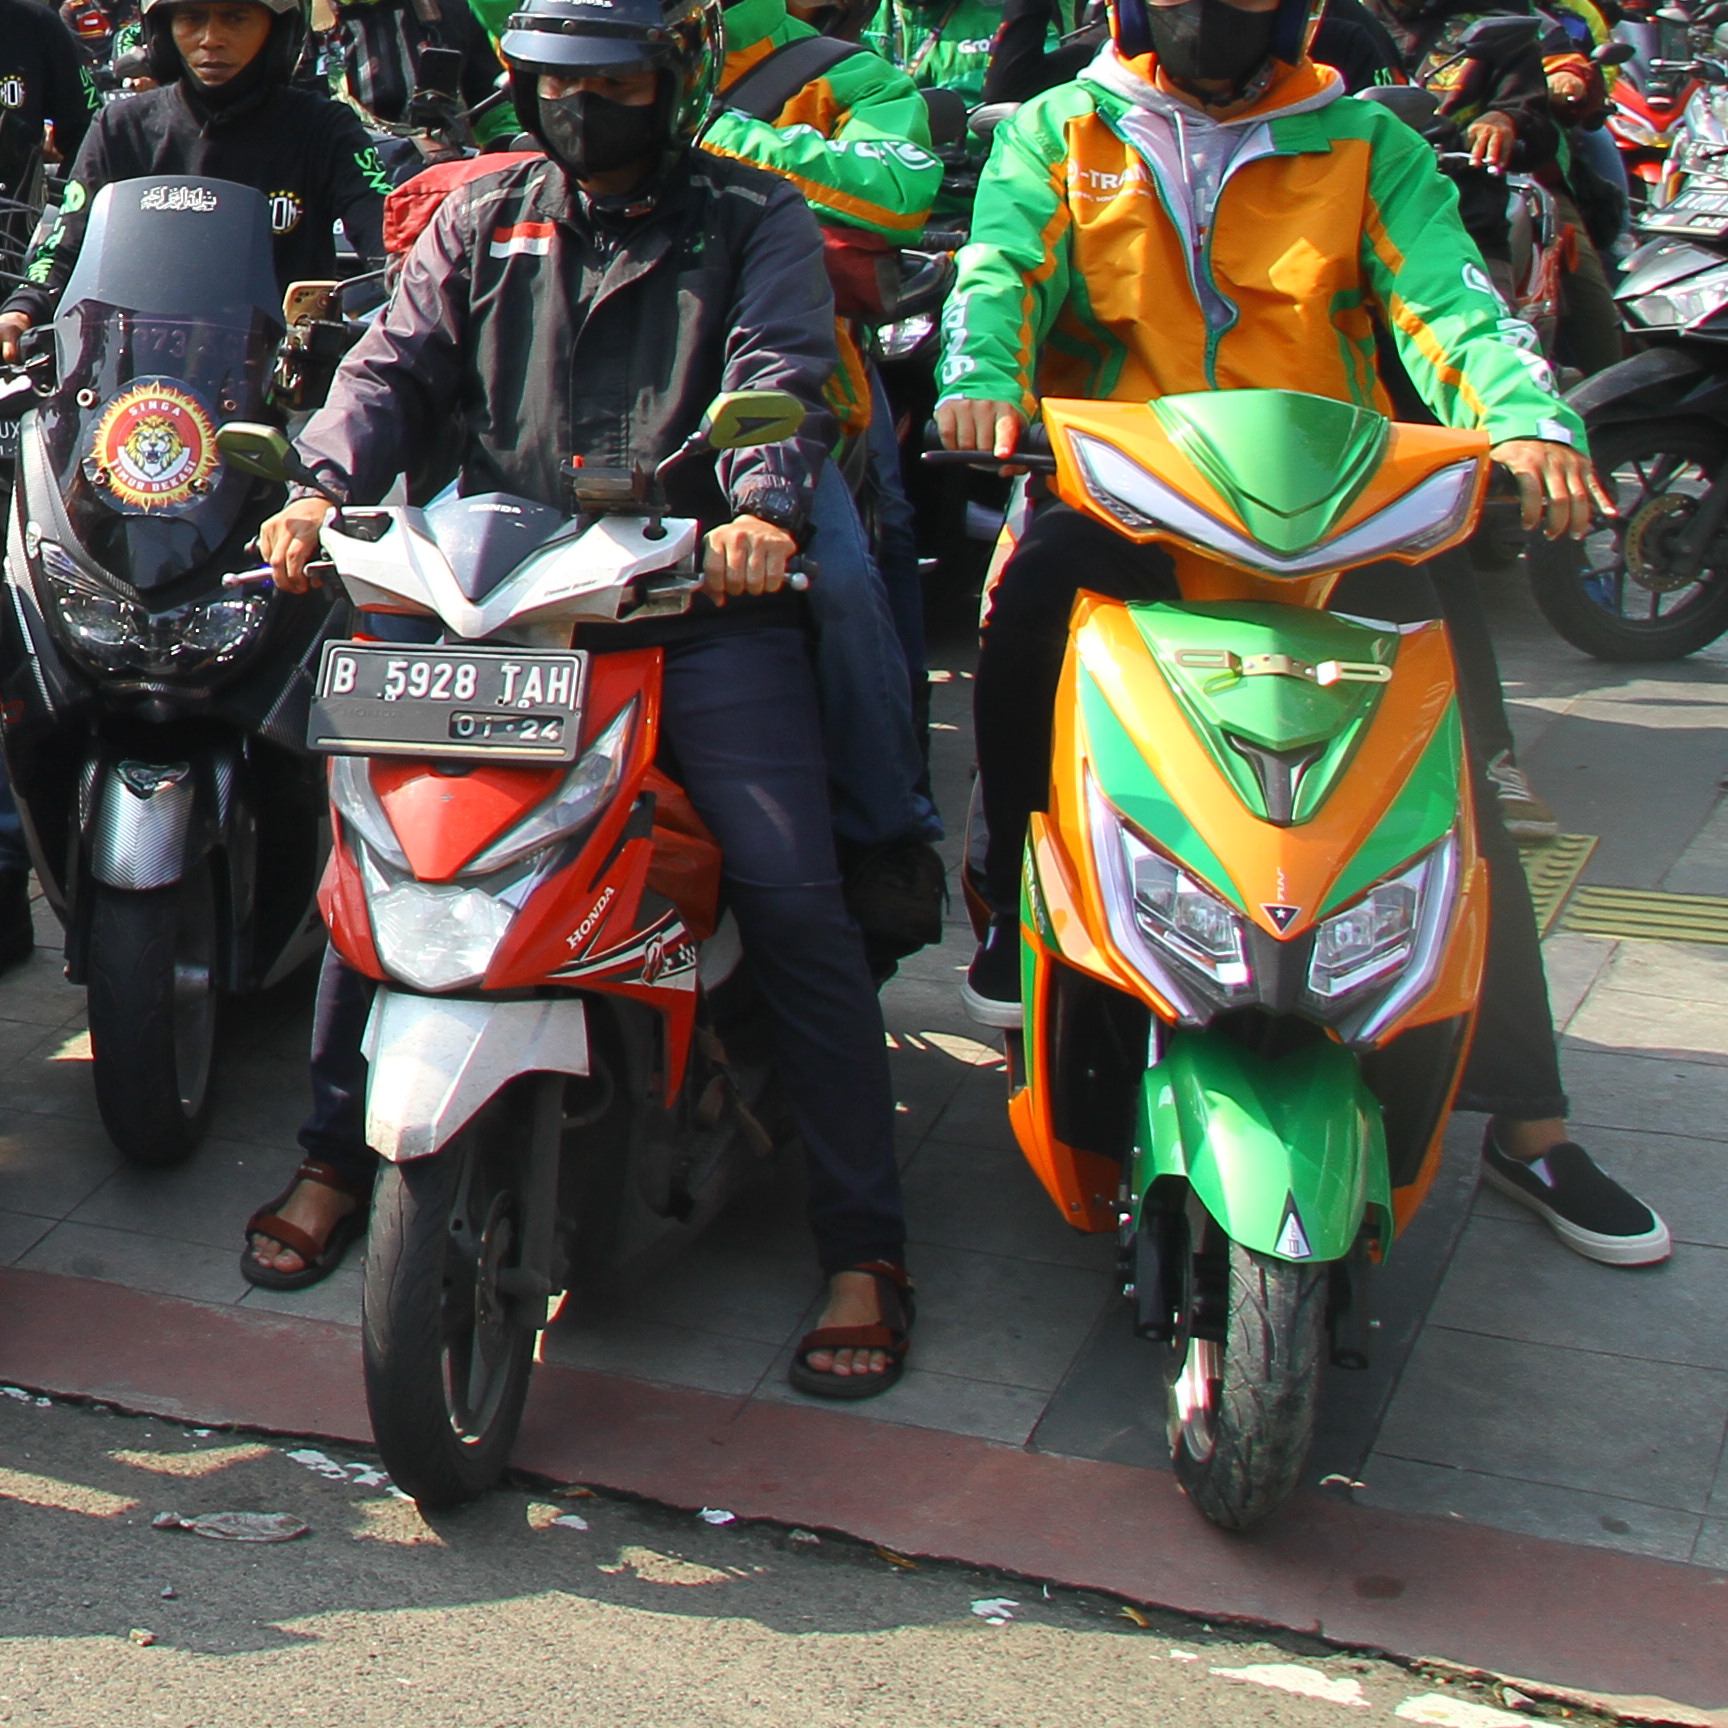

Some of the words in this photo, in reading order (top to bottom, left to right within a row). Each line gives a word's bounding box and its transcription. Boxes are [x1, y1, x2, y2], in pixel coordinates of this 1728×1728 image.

[957, 36, 991, 55] Gra
[127, 397, 182, 416] SINGA
[110, 460, 146, 492] TIMUR
[151, 458, 197, 493] BEKASI
[468, 502, 522, 515] HONDA
[332, 657, 357, 694] B
[384, 660, 477, 702] 5928
[500, 662, 571, 705] TAH
[566, 886, 616, 950] HONDA
